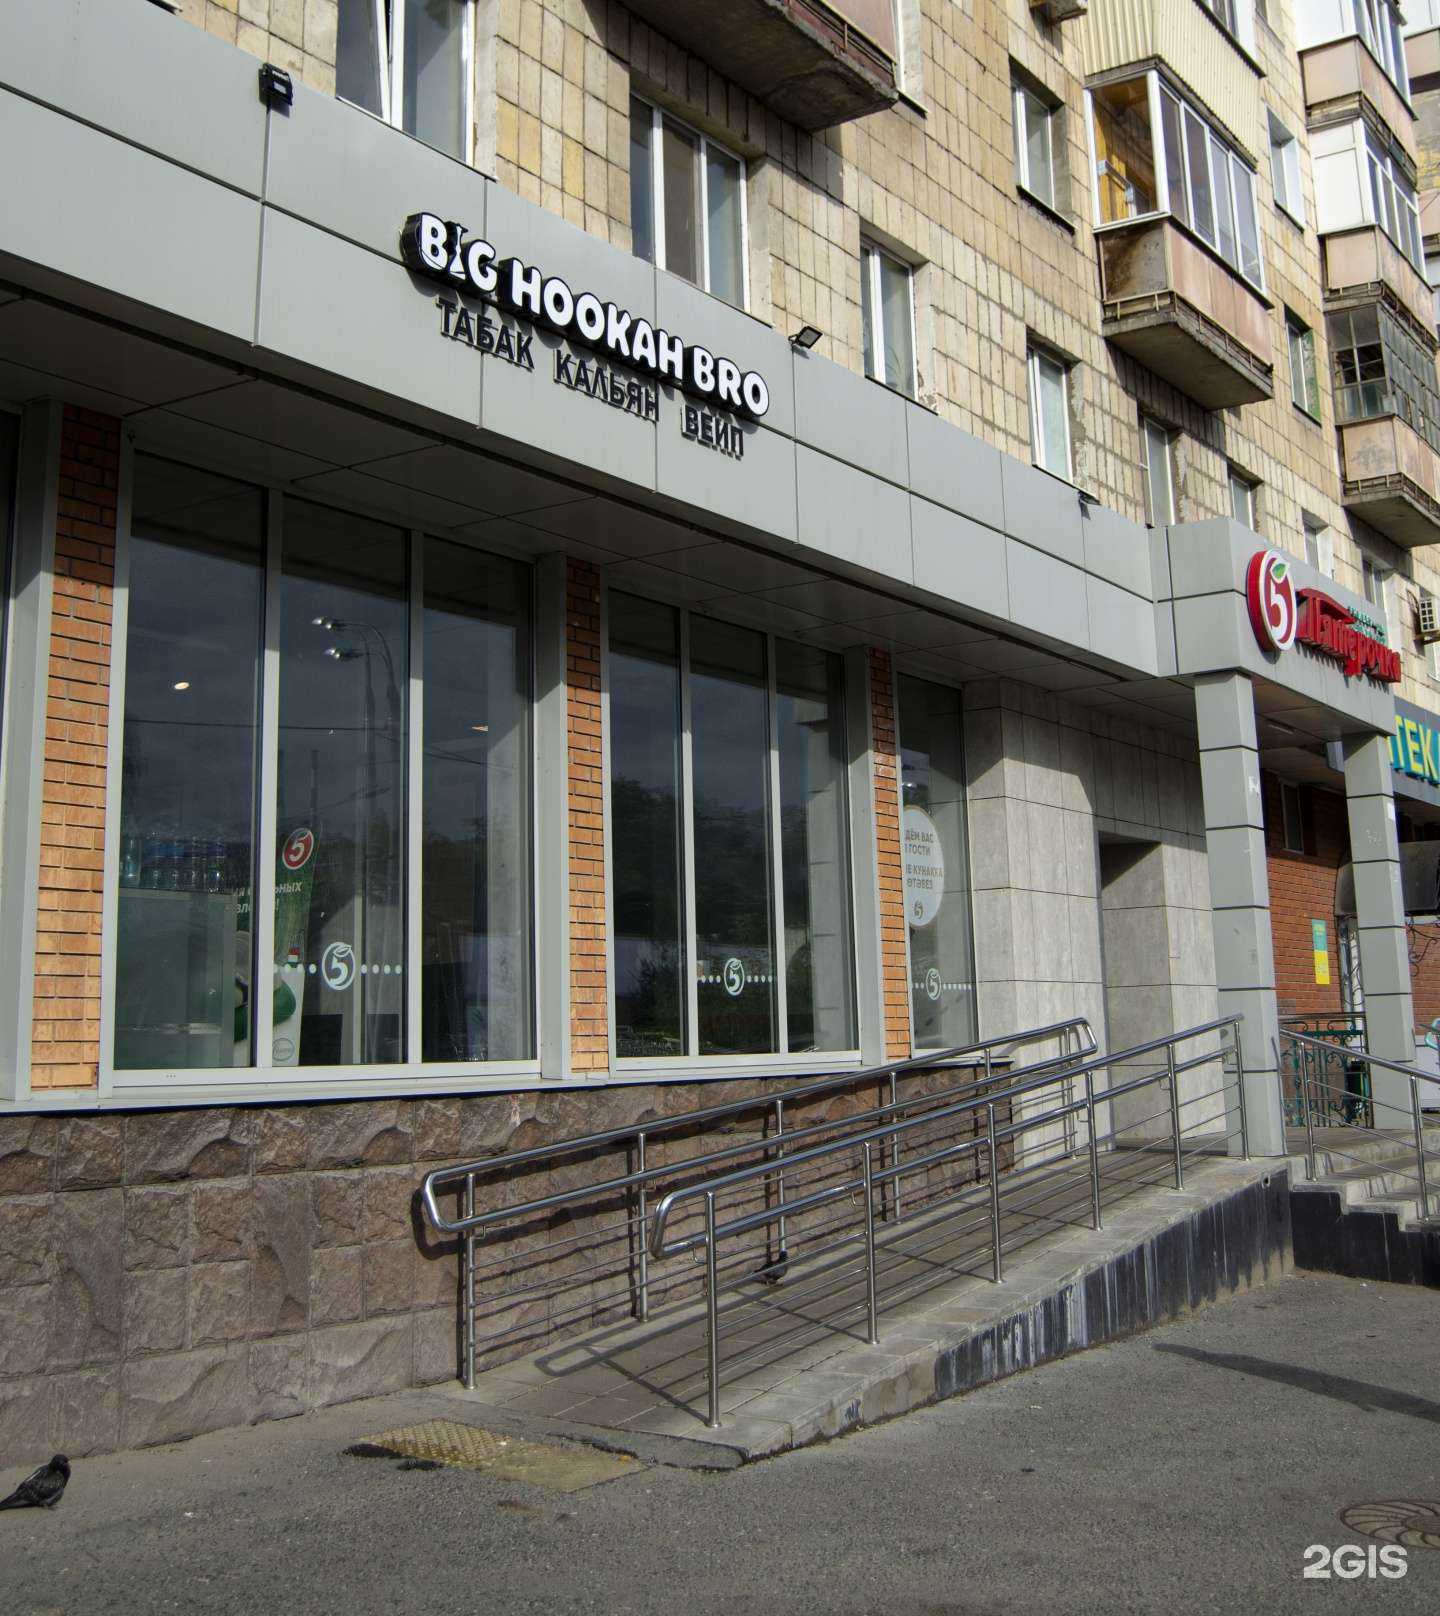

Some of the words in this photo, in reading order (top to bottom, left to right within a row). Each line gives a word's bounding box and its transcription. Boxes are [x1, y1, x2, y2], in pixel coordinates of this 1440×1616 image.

[436, 298, 535, 371] ТАБАК
[553, 347, 660, 424] КАЛЬЯН
[507, 257, 684, 382] HOOKAH
[691, 345, 770, 418] BRO
